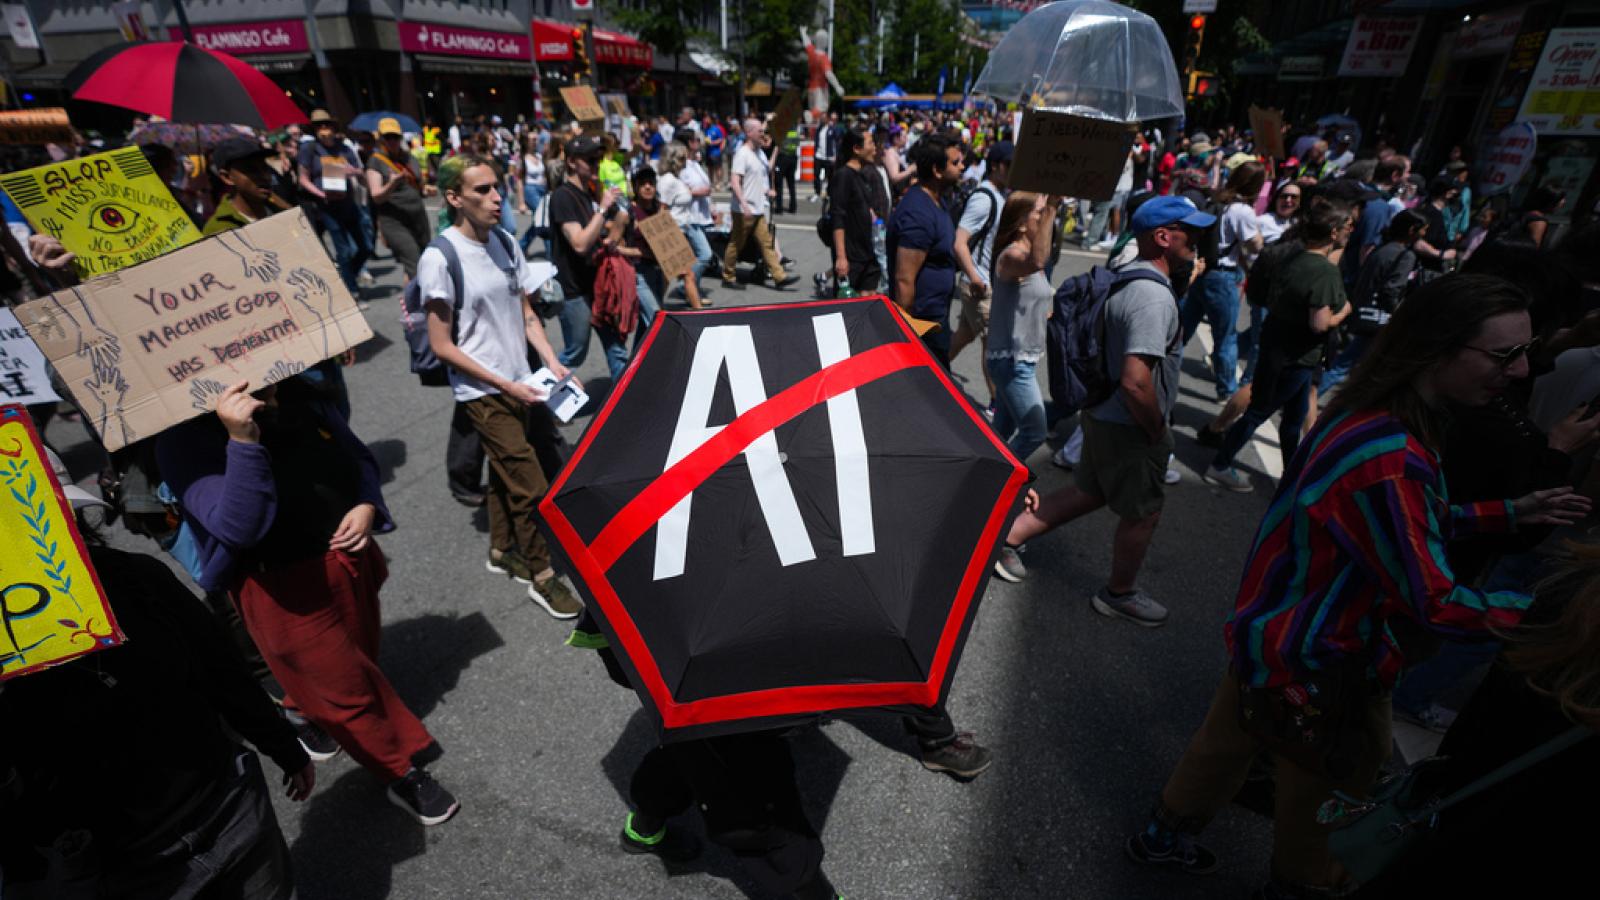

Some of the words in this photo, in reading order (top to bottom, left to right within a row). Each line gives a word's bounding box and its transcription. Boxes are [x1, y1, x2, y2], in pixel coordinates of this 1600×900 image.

[195, 30, 261, 49] FLAMINGO
[262, 27, 291, 47] Cafe
[431, 31, 495, 53] FLAMINGO
[497, 38, 521, 56] Cafe
[1359, 19, 1417, 31] Kitchen
[1369, 32, 1411, 50] Bar
[1032, 117, 1046, 136] I
[1048, 121, 1079, 137] NEED
[44, 159, 113, 197] SLOP
[56, 182, 96, 221] MASS
[133, 272, 236, 315] YOUR
[139, 303, 232, 353] MACHINE
[235, 290, 281, 315] GOD
[168, 356, 205, 383] HAS
[210, 318, 299, 364] DEMENTIA
[653, 312, 876, 581] AI
